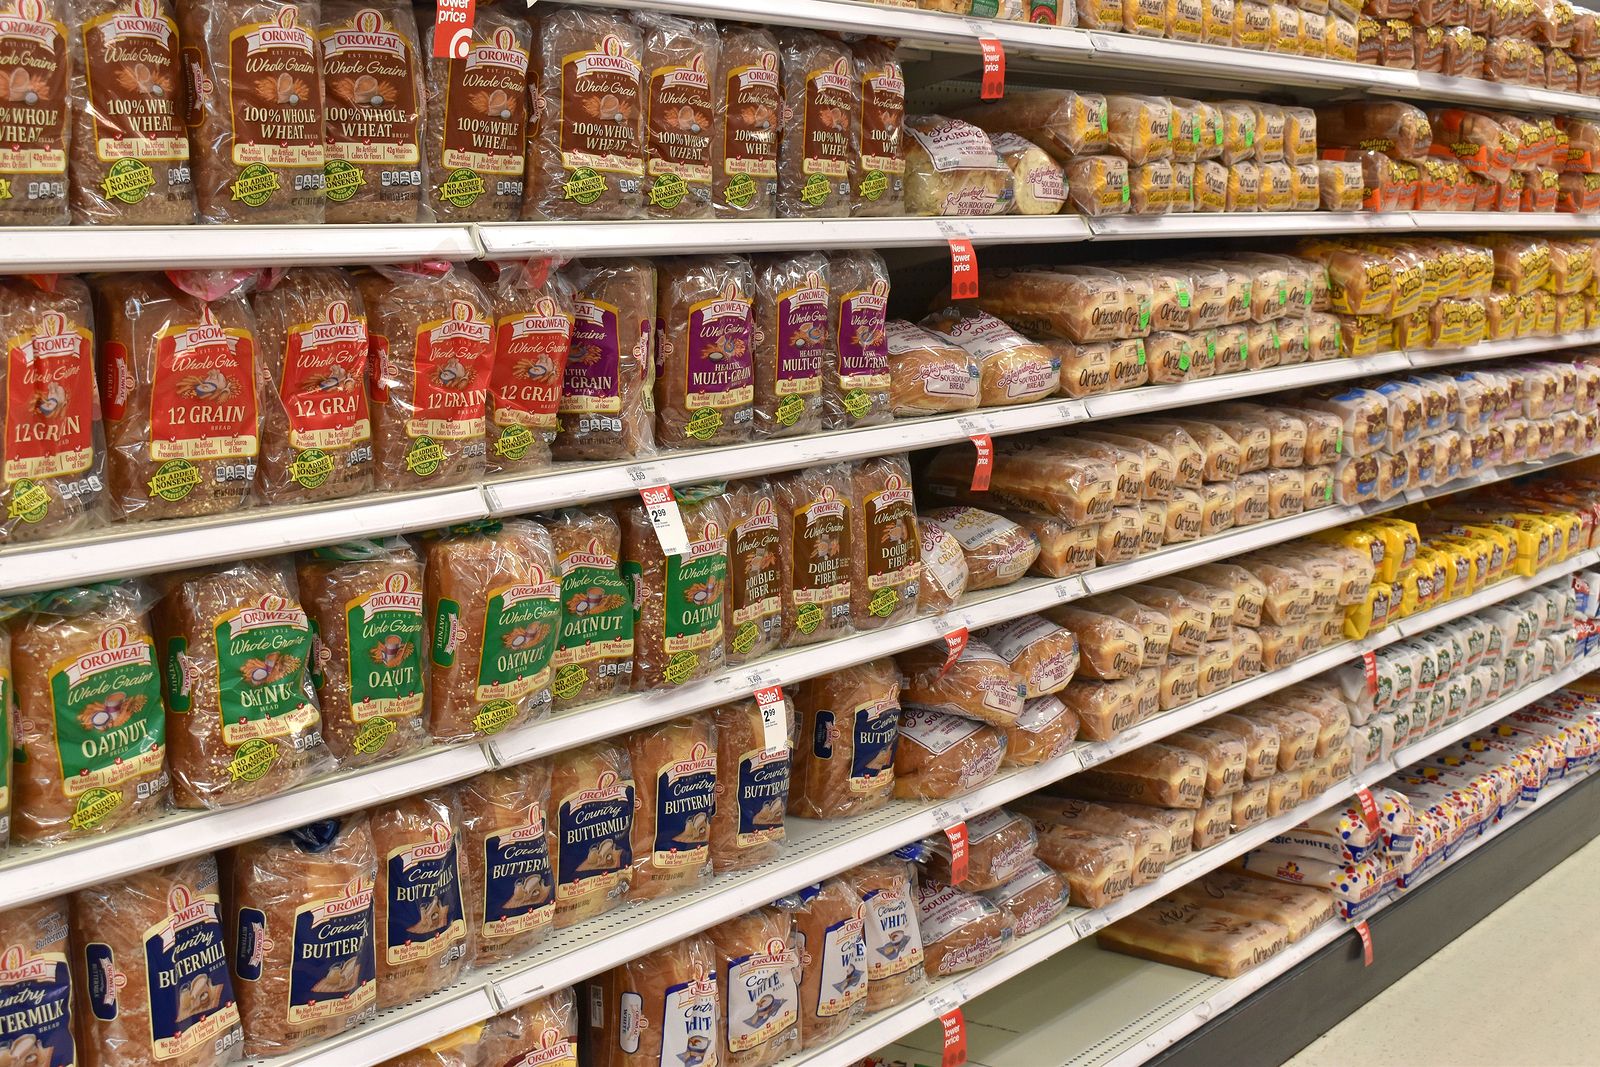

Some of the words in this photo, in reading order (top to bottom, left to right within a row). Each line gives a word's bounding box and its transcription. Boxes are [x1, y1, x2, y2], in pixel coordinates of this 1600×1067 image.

[438, 9, 467, 24] price
[117, 19, 164, 35] OROWEAT
[337, 34, 398, 48] OROWEAT
[982, 44, 995, 52] New
[105, 48, 138, 64] Whole
[478, 50, 524, 65] OROWEAT
[984, 54, 1000, 62] lower
[246, 58, 284, 73] Whole
[324, 59, 365, 74] Whole
[366, 62, 407, 78] Grains
[985, 64, 998, 73] price
[463, 74, 500, 88] Whole
[576, 81, 609, 93] Whole
[660, 93, 687, 104] Whole
[107, 100, 144, 115] 100%
[13, 110, 58, 125] WHOLE
[244, 108, 281, 122] 100%
[282, 109, 316, 123] WHOLE
[361, 109, 406, 123] WHOLE
[129, 117, 172, 132] WHEAT
[342, 124, 392, 138] WHEAT
[457, 117, 489, 132] 100%
[572, 122, 603, 136] 100%
[261, 124, 304, 140] WHEAT
[658, 133, 684, 145] 100%
[813, 131, 833, 142] 100%
[587, 137, 627, 150] WHEAT
[109, 177, 124, 186] NO
[125, 169, 149, 181] ADDED
[238, 180, 250, 188] NO
[252, 175, 273, 186] ADDED
[331, 170, 358, 182] ADDED
[581, 177, 601, 188] ADDED
[111, 175, 151, 193] NONSENSE
[239, 181, 274, 196] NONSENSE
[446, 182, 456, 190] NO
[457, 179, 480, 189] ADDED
[446, 183, 480, 195] NONSENSE
[666, 183, 685, 193] ADDED
[655, 189, 686, 201] NONSENSE
[951, 244, 965, 253] New
[954, 254, 970, 263] lower
[954, 263, 970, 273] price
[526, 318, 566, 329] OROWEAT
[788, 313, 811, 325] Whole
[508, 342, 545, 354] Whole
[172, 355, 213, 372] Whole
[297, 352, 333, 368] Whole
[500, 386, 516, 400] 12
[428, 393, 442, 410] 12
[168, 407, 186, 425] 12
[190, 406, 246, 424] GRAIN
[295, 400, 316, 418] 12
[15, 424, 31, 442] 12
[512, 432, 530, 444] ADDED
[501, 437, 531, 450] NONSENSE
[307, 457, 329, 468] ADDED
[977, 457, 988, 465] price
[154, 474, 168, 483] NO
[170, 467, 194, 480] ADDED
[156, 474, 196, 489] NONSENSE
[643, 489, 670, 504] Sale!
[804, 527, 826, 539] Whole
[808, 558, 839, 575] DOUBLE
[679, 569, 710, 581] Whole
[814, 573, 837, 585] FIBER
[371, 595, 421, 606] OROWEAT
[499, 608, 533, 626] Whole
[564, 616, 623, 637] OATNUT
[230, 638, 270, 656] Whole
[80, 645, 143, 671] OROWEAT
[497, 647, 545, 673] OATNUT
[68, 682, 111, 707] Whole
[112, 671, 153, 692] Grains
[757, 688, 780, 704] Sale!
[81, 718, 148, 759] OATNUT
[234, 758, 248, 767] NO
[249, 748, 274, 763] ADDED
[237, 754, 276, 772] NONSENSE
[673, 779, 715, 796] Country
[91, 794, 116, 812] ADDED
[575, 804, 622, 825] Country
[948, 832, 961, 841] New
[952, 842, 964, 851] lower
[952, 850, 964, 861] price
[943, 1018, 956, 1030] New
[945, 1025, 960, 1037] lower
[945, 1035, 959, 1048] price
[527, 1044, 567, 1066] OROWEAT
